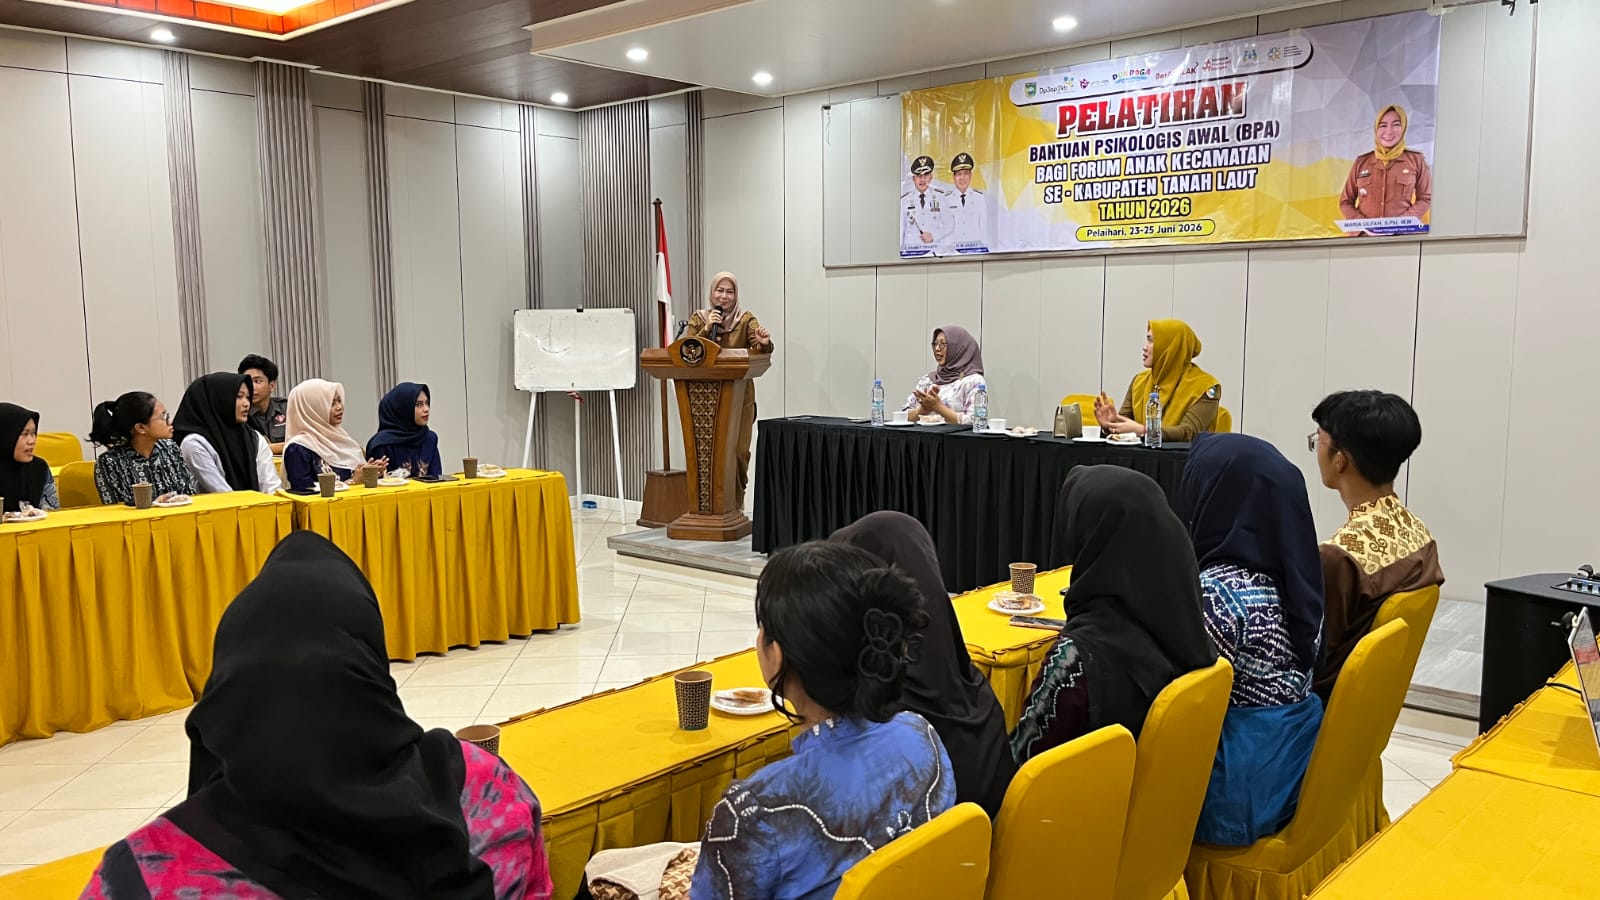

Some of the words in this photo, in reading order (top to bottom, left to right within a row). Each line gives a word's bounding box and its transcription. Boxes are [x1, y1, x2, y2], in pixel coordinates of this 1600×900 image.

[1057, 82, 1247, 137] PELATIHAN
[1029, 140, 1090, 162] BANTUAN
[1094, 133, 1182, 155] PSIKOLOGIS
[1186, 125, 1229, 147] AWAL
[1235, 120, 1280, 143] (BPA)
[1035, 163, 1067, 183] BAGI
[1070, 158, 1121, 181] FORUM
[1124, 153, 1167, 176] ANAK
[1170, 144, 1271, 172] KECAMATAN
[1043, 185, 1062, 204] SE
[1074, 177, 1157, 202] KABUPATEN
[1160, 172, 1212, 196] TANAH
[1216, 169, 1258, 192] LAUT
[1099, 200, 1147, 222] TAHUN
[1148, 197, 1191, 219] 2026
[1086, 226, 1126, 238] Pelaihari,
[1129, 225, 1155, 235] 23-25
[1157, 224, 1176, 235] Juni
[1178, 223, 1203, 233] 2026
